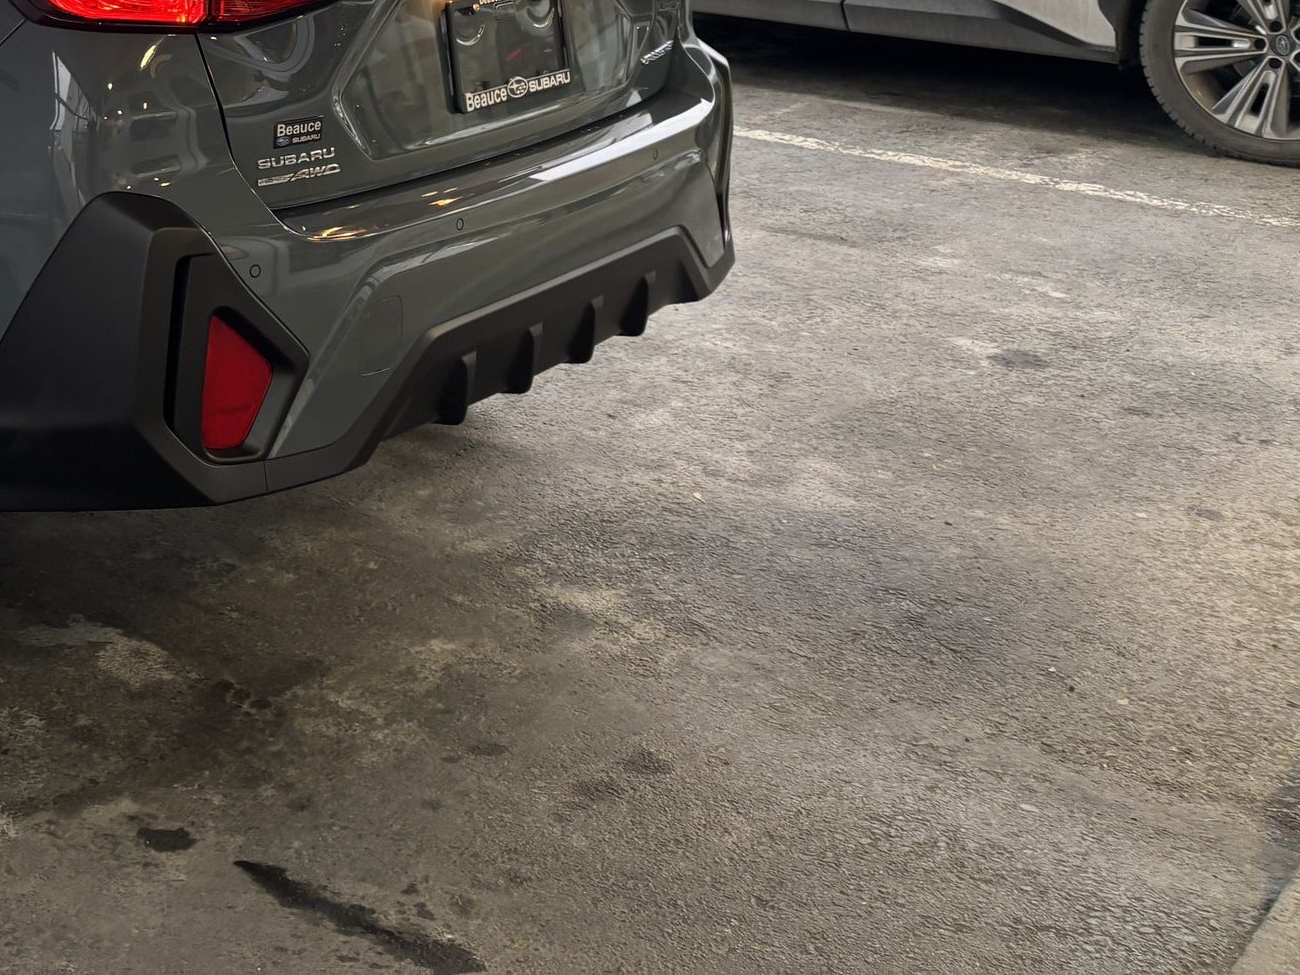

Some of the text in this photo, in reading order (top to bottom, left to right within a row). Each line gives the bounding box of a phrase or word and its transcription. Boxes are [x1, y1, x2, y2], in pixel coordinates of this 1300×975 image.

[465, 71, 571, 112] Beauce SUBARU
[277, 121, 322, 137] Beauce
[292, 133, 321, 144] SUBARU
[257, 147, 335, 169] SUBARU
